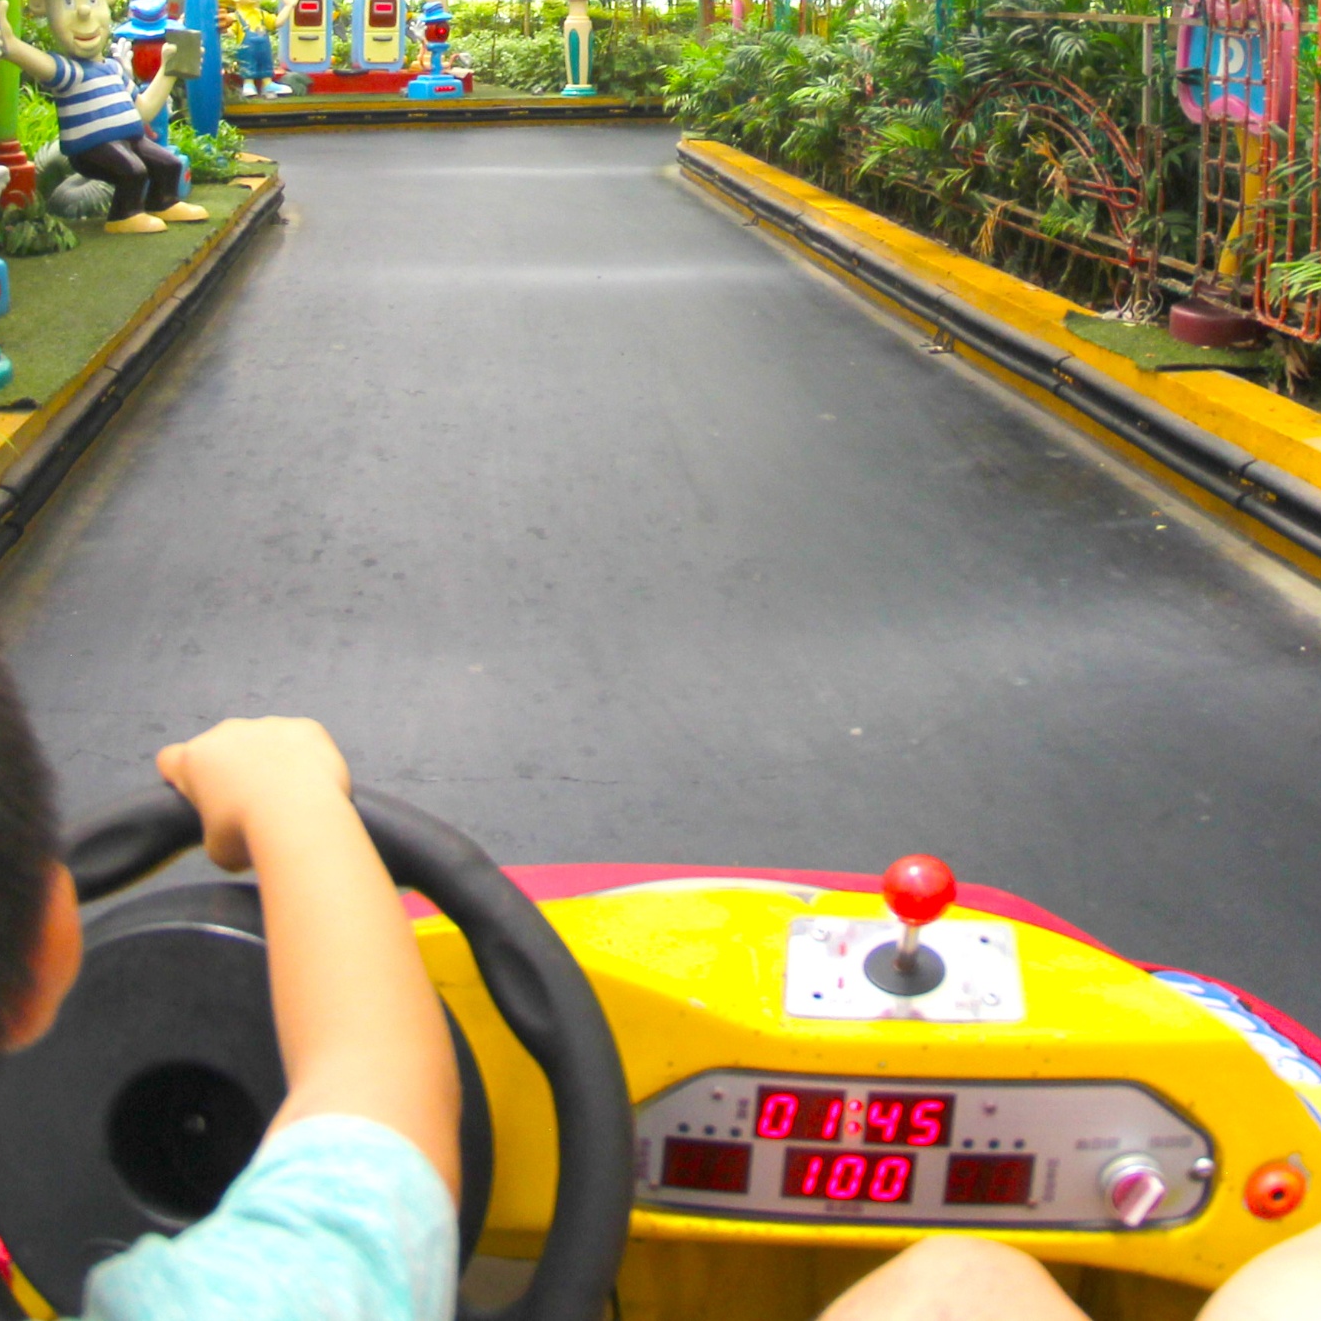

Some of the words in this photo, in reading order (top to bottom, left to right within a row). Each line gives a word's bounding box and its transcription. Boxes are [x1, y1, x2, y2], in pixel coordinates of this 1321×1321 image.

[1214, 36, 1245, 86] P
[757, 1092, 946, 1147] 01:45
[802, 1154, 912, 1203] 100
